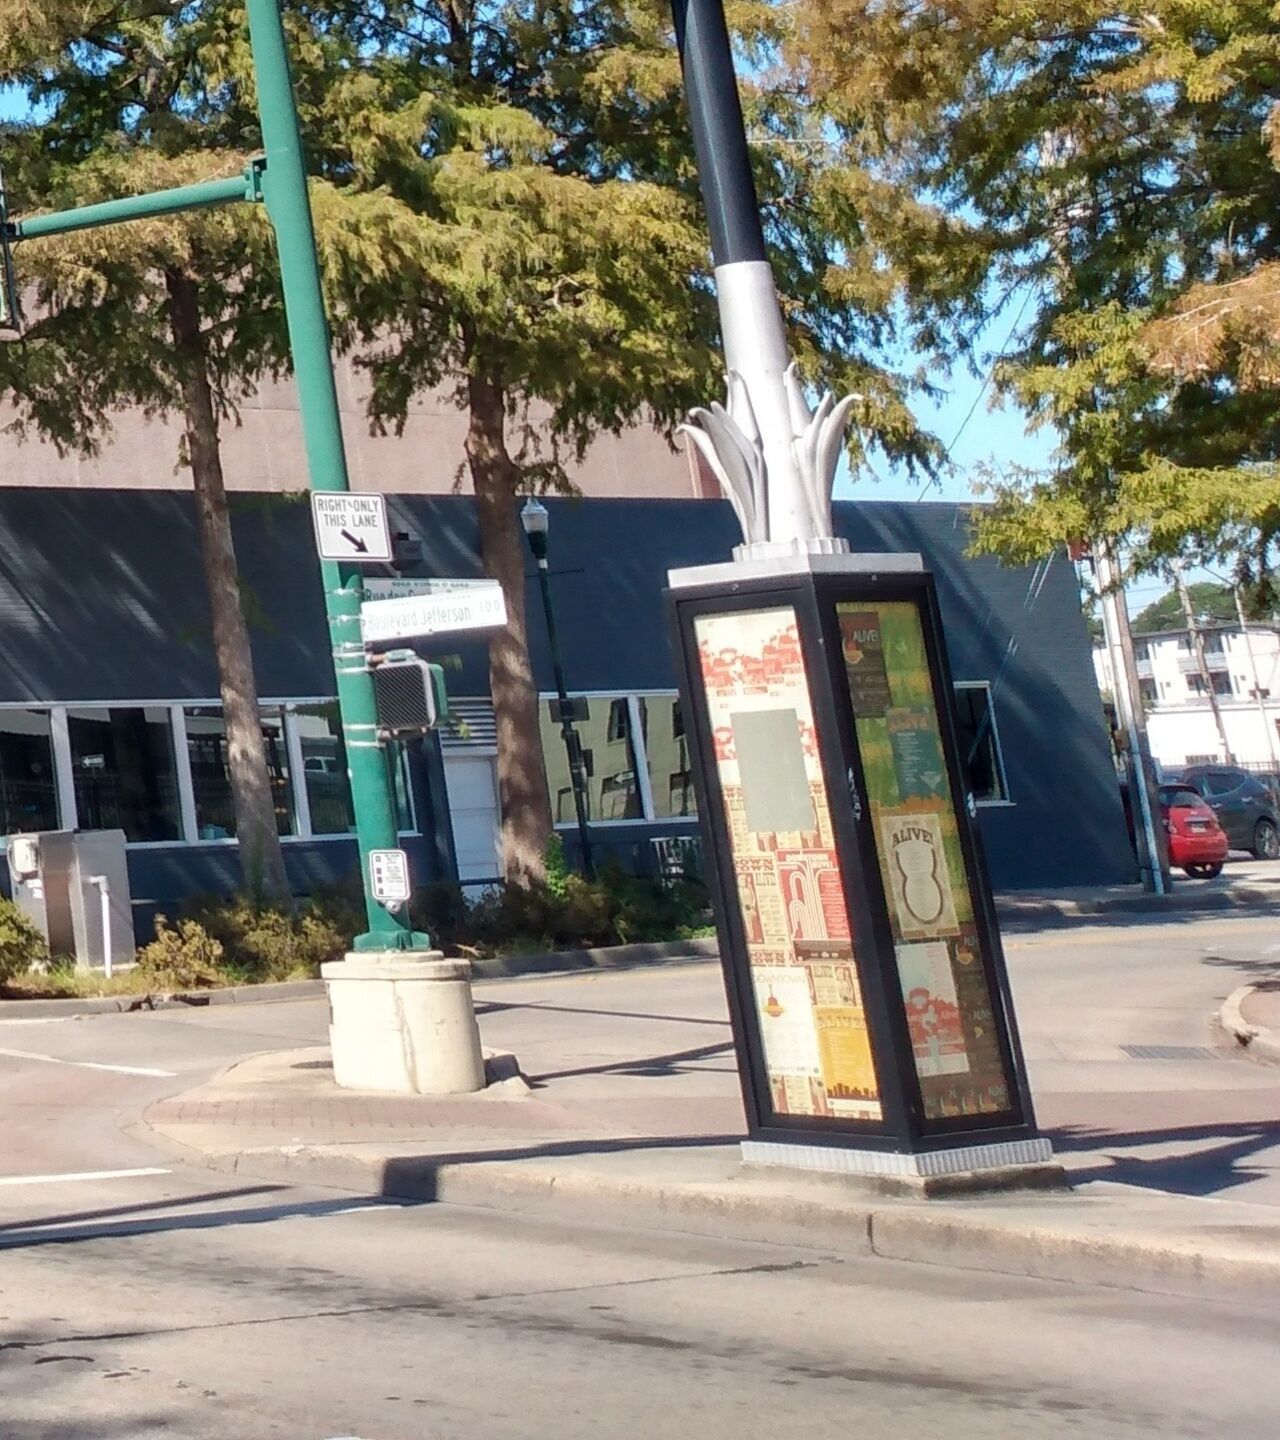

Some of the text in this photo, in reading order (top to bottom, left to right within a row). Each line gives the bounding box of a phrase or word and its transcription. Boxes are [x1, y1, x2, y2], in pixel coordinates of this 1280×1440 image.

[317, 498, 379, 513] RIGHT ONLY
[323, 513, 379, 528] THIS LANE
[367, 599, 500, 631] Boulevard Jefferson 100
[892, 826, 934, 848] ALIVE!
